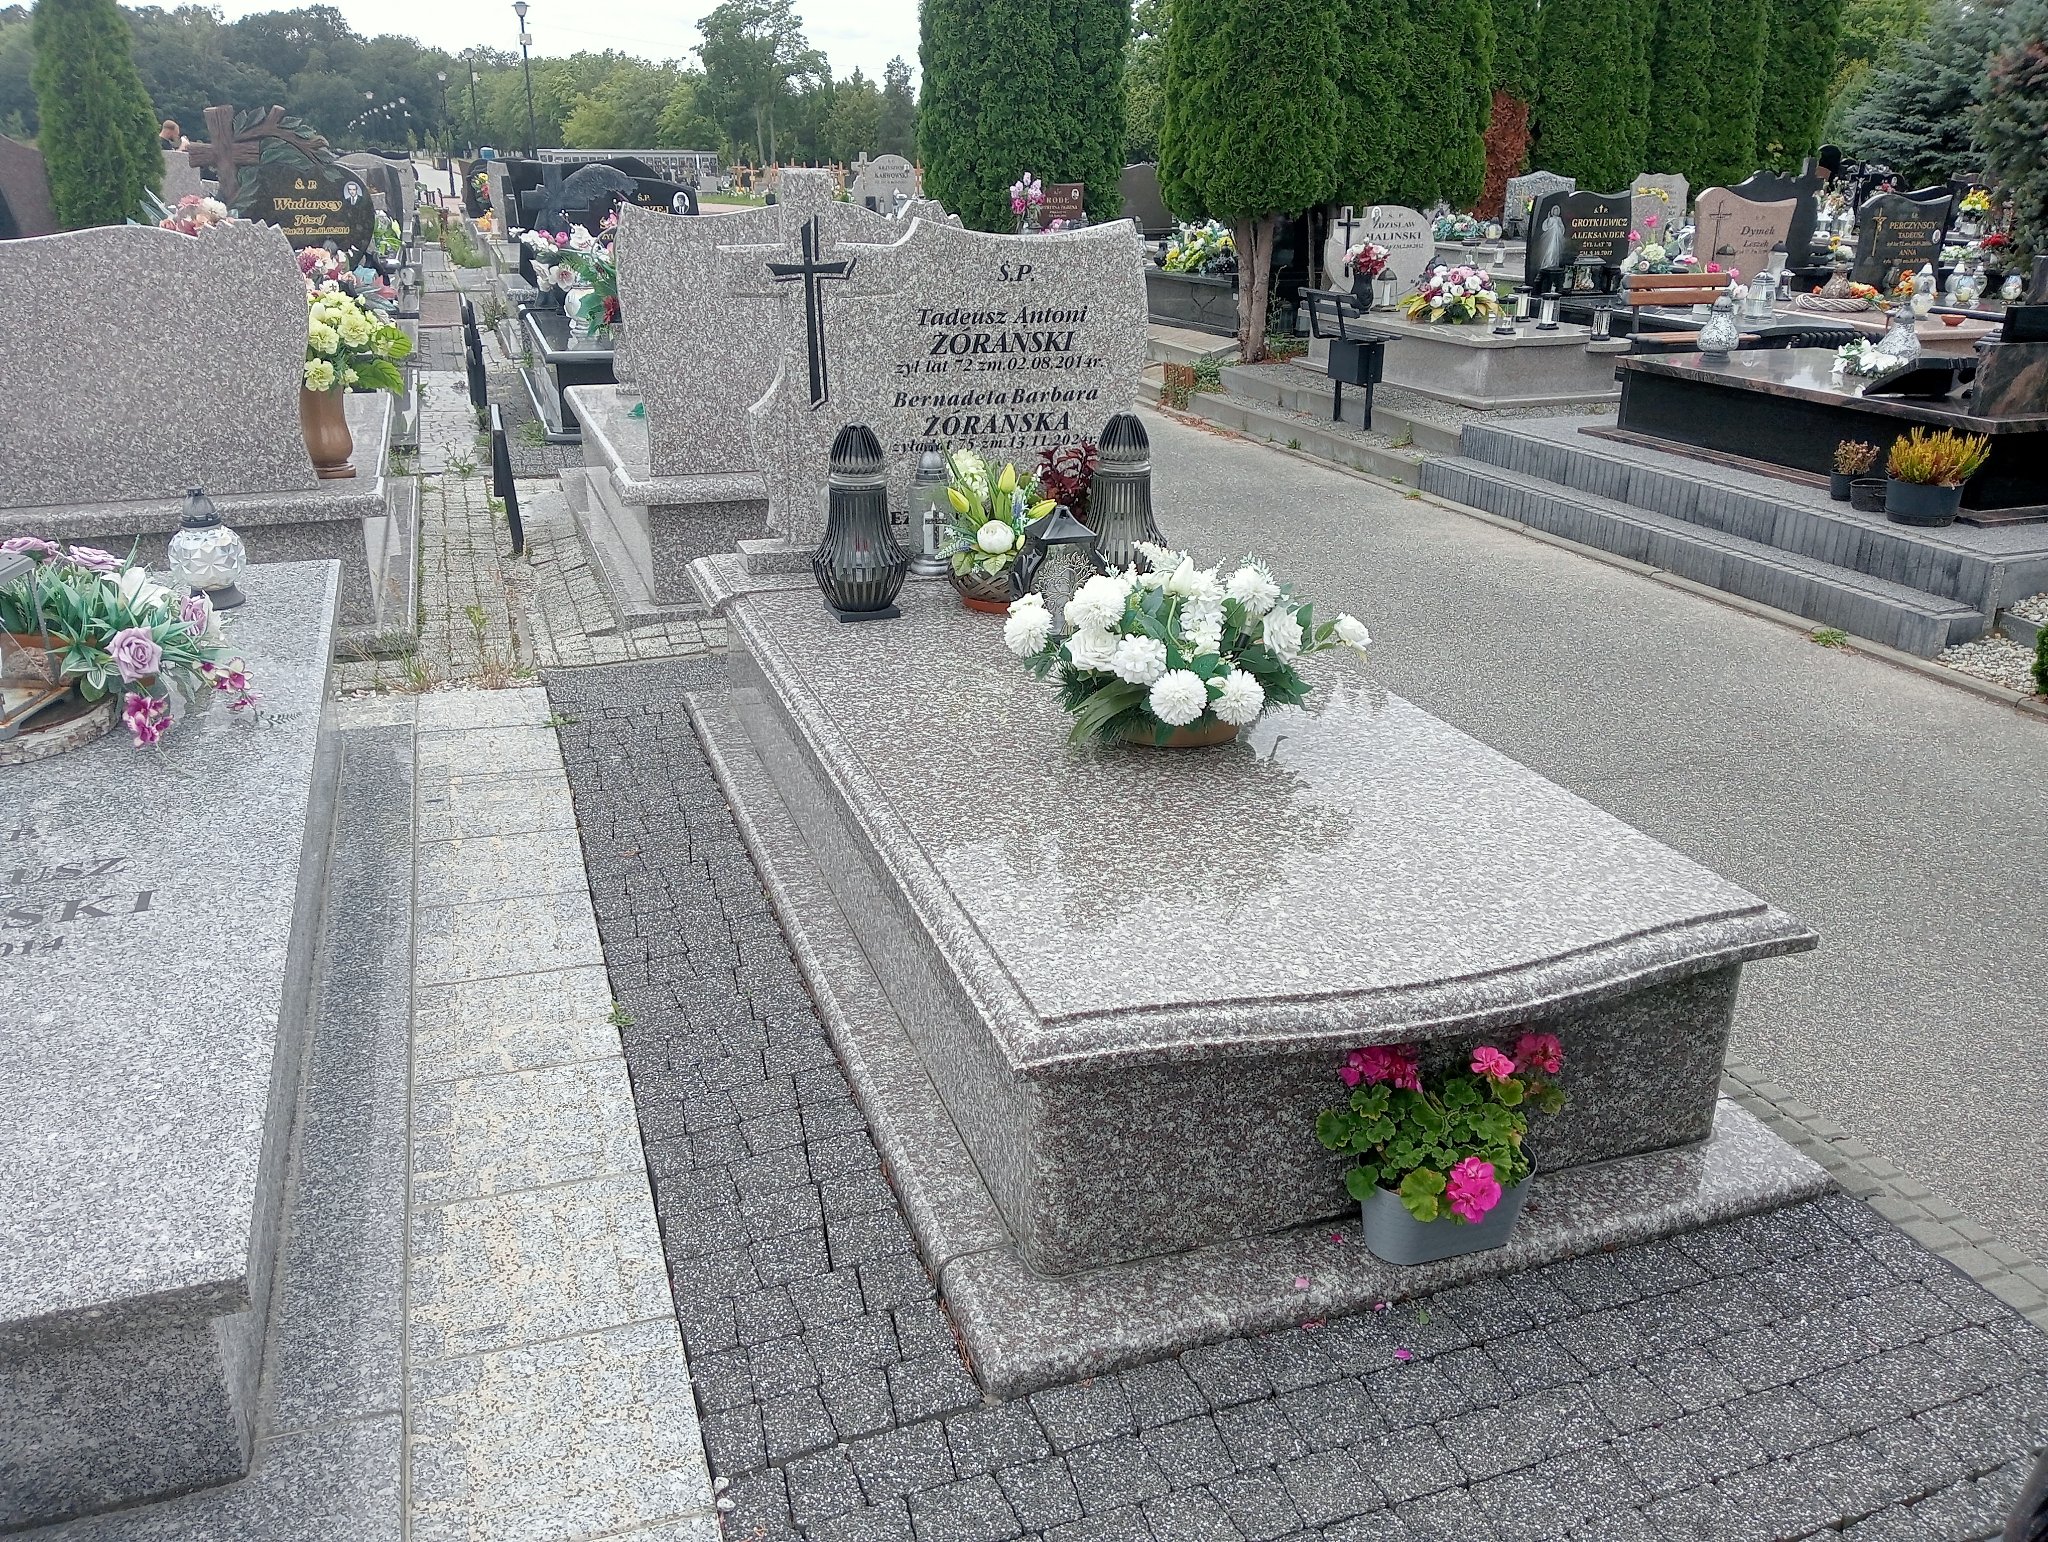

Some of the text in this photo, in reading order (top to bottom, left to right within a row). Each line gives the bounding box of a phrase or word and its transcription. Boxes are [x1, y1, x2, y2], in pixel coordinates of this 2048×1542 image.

[273, 197, 342, 211] Wudarscy
[294, 214, 327, 227] Józef
[1571, 218, 1628, 227] GROTKIEWICZ
[1571, 231, 1625, 239] ALEKSANDER
[1740, 225, 1776, 237] Dymek
[1897, 231, 1925, 239] TADEUSZ
[1743, 240, 1769, 248] Leszek
[917, 305, 1088, 326] Tadeusz Antoni
[926, 360, 948, 373] lat
[955, 358, 973, 373] 72
[893, 387, 1099, 408] Bernadeta Barbara
